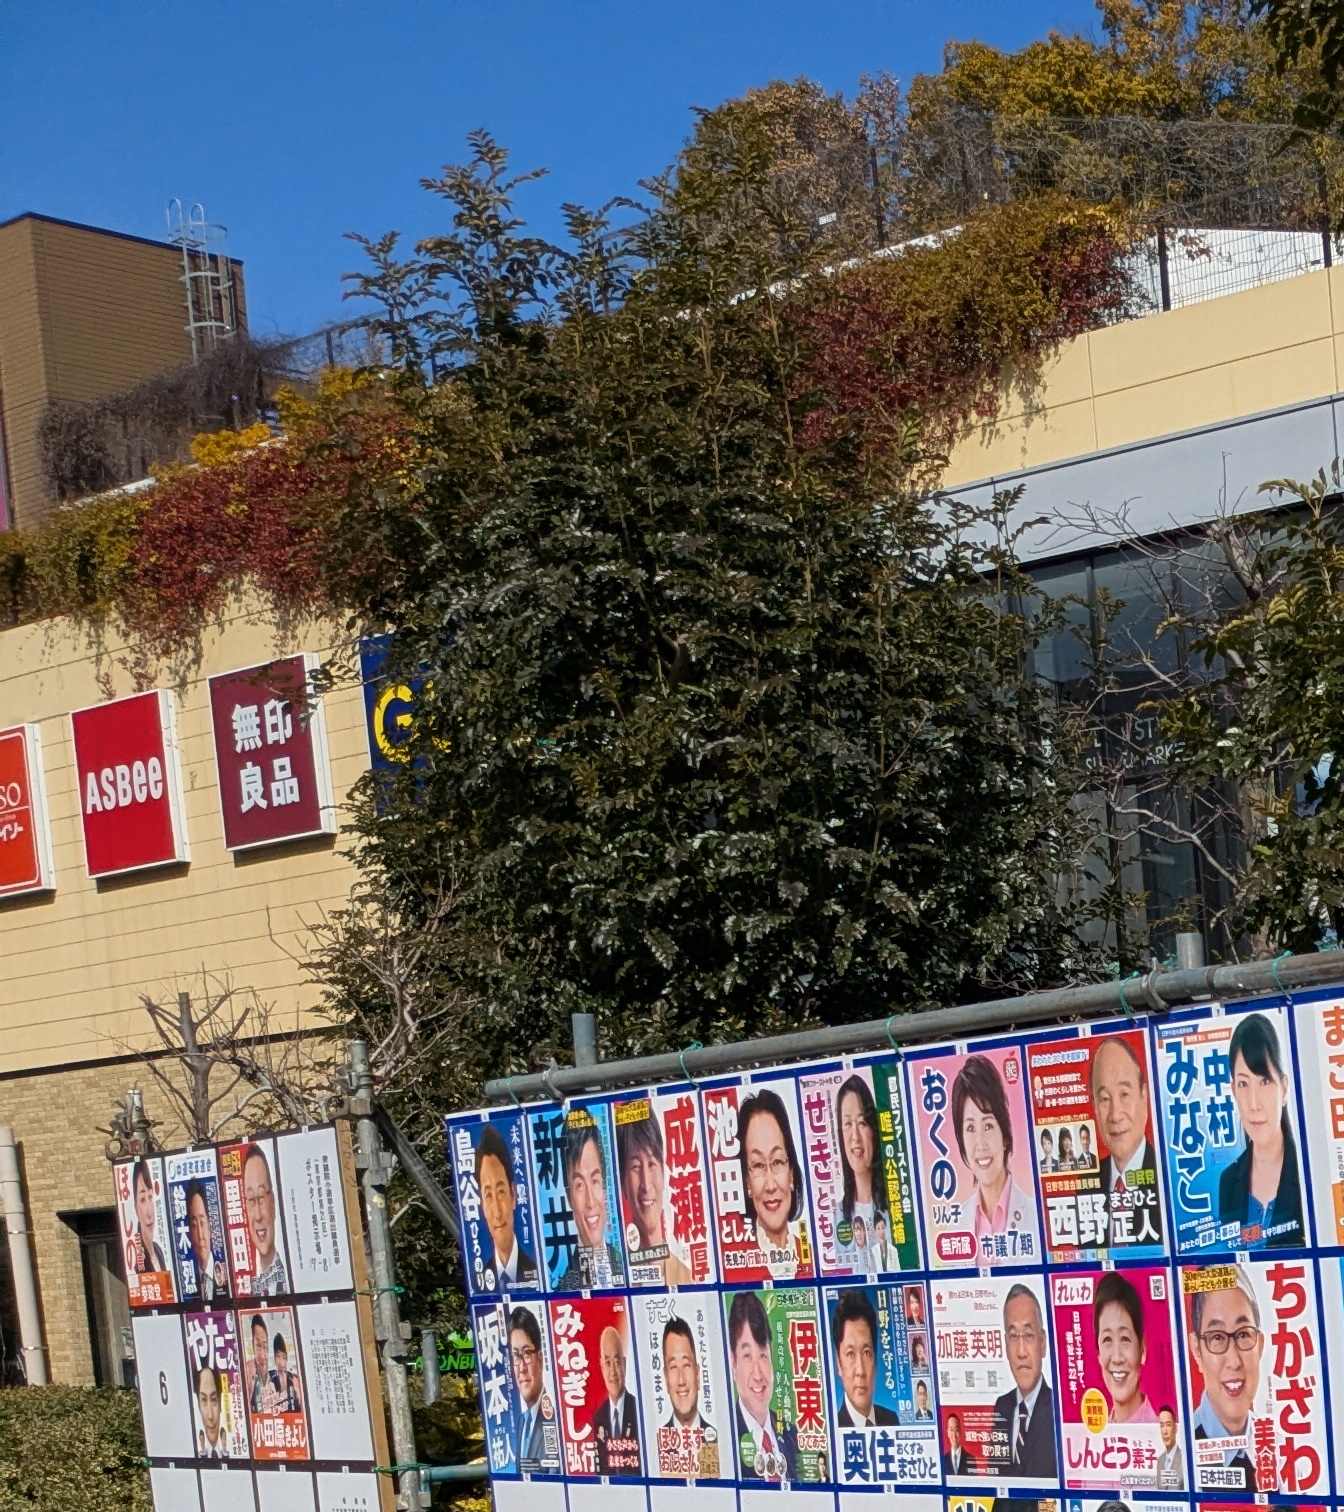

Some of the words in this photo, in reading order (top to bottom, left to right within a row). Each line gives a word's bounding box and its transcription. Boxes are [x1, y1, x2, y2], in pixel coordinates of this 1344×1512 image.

[231, 698, 293, 754] 無印
[85, 755, 164, 815] ASBee
[239, 755, 301, 814] 良品
[1203, 1048, 1237, 1147] 中村
[919, 1067, 958, 1201] おくの
[1164, 1040, 1212, 1213] みなこ
[455, 1128, 481, 1222] 島谷
[707, 1096, 747, 1216] 池田
[532, 1113, 579, 1272] 新井
[663, 1094, 708, 1244] 成瀬
[689, 1242, 710, 1283] 厚
[932, 1203, 962, 1226] りん子
[1109, 1189, 1158, 1208] まさひと
[721, 1216, 757, 1244] としえ
[940, 1236, 971, 1256] 無所属
[980, 1230, 1034, 1258] 市議7期
[1046, 1193, 1109, 1247] 西野
[1112, 1208, 1161, 1244] 正人
[1057, 1280, 1092, 1303] れいわ
[477, 1306, 510, 1426] 坂本
[695, 1308, 713, 1416] あなたと日野市
[936, 1328, 1004, 1360] 加藤英明
[159, 1370, 169, 1406] 6
[553, 1303, 593, 1441] みねぎし
[788, 1319, 827, 1433] 伊東
[1265, 1262, 1321, 1494] ちかざわ
[253, 1417, 307, 1449] 小田原きよし
[566, 1442, 596, 1473] 弘行
[658, 1427, 705, 1451] ほめます
[842, 1429, 897, 1484] 奥住
[896, 1442, 924, 1457] おくずみ
[1066, 1435, 1131, 1470] しんどう
[1132, 1447, 1158, 1470] 素子
[658, 1450, 701, 1474] おじさん
[897, 1457, 939, 1480] まさひと
[1200, 1469, 1243, 1487] 日本共産党
